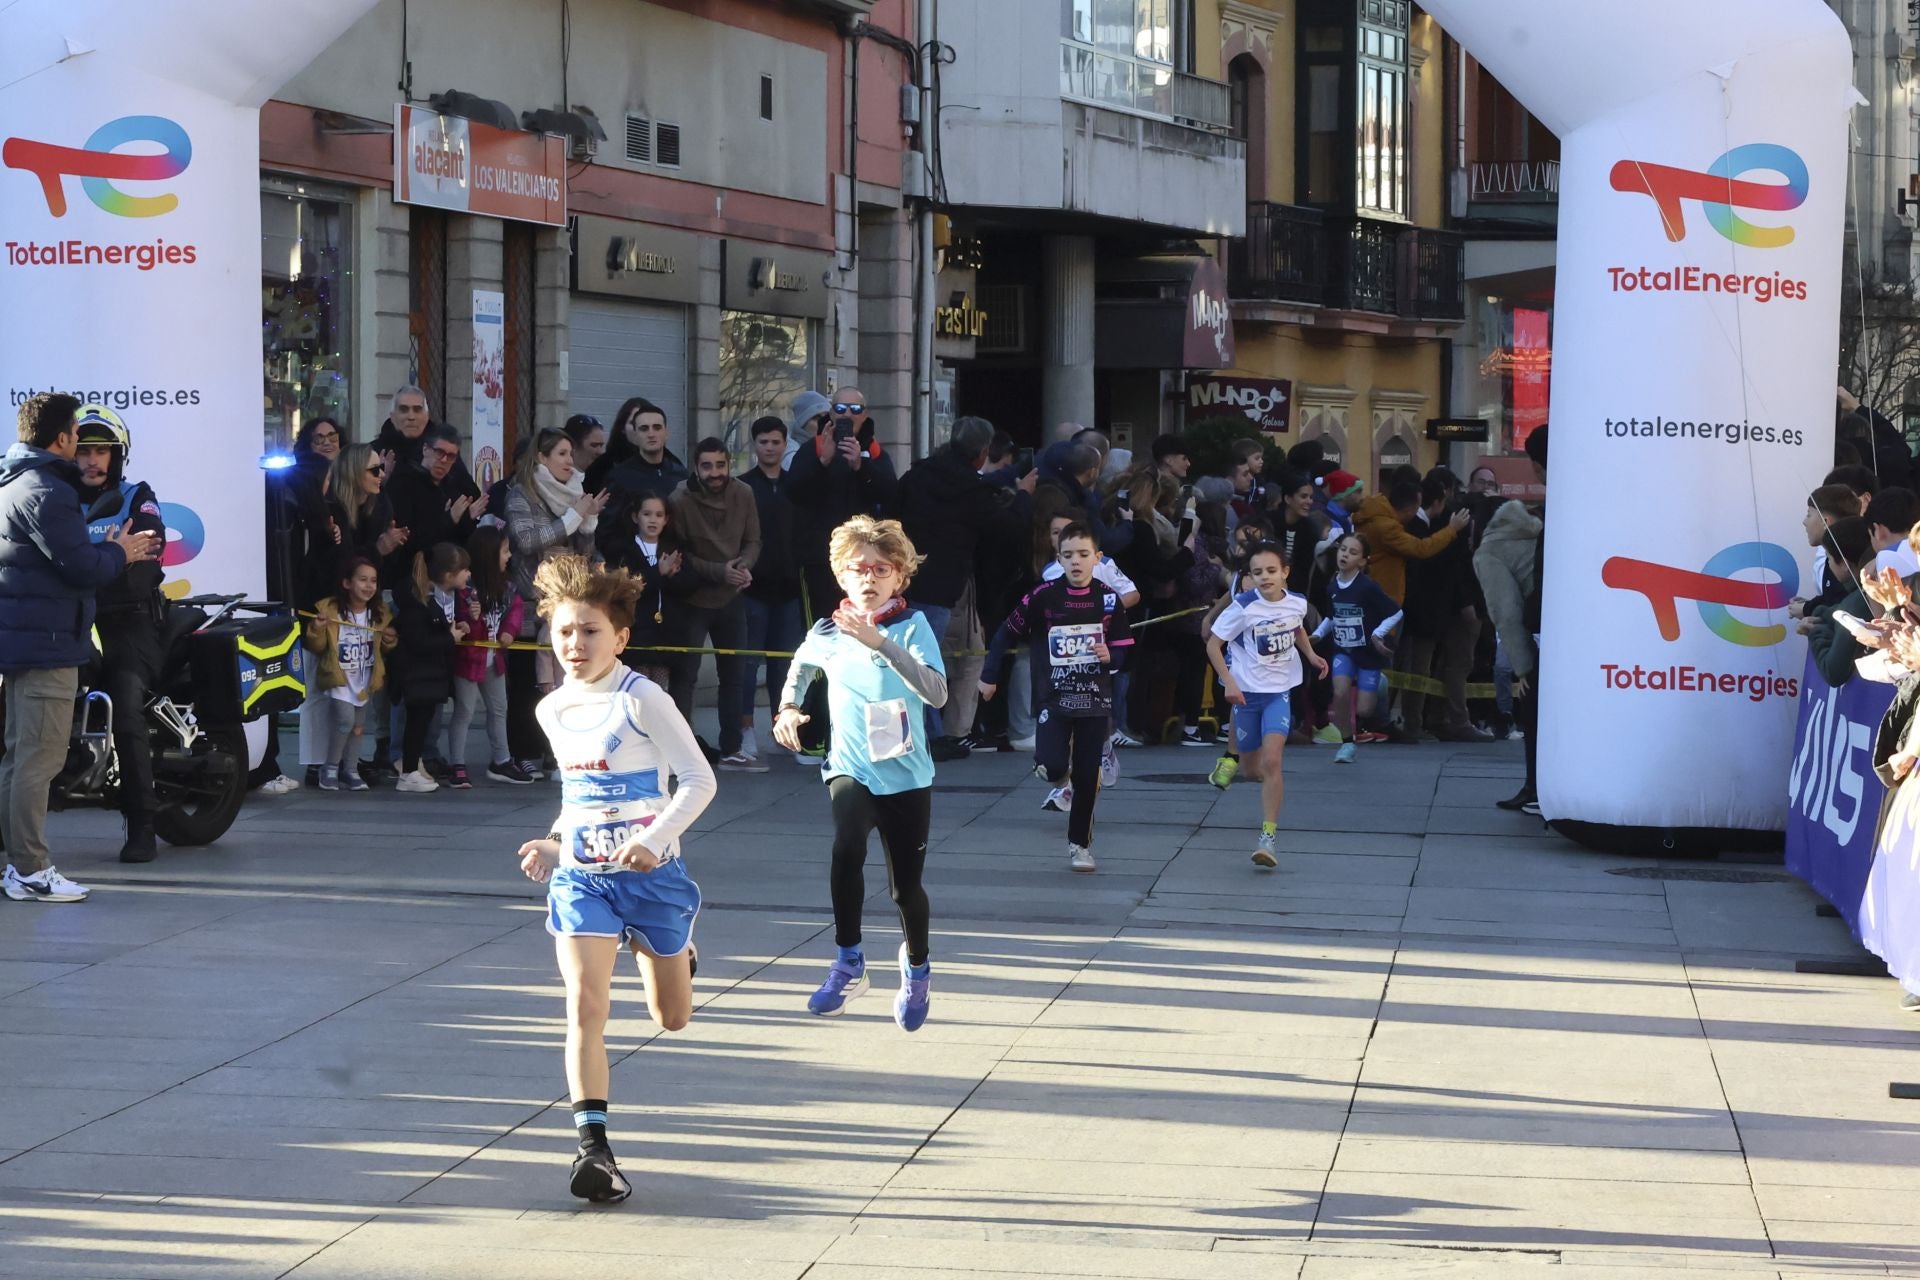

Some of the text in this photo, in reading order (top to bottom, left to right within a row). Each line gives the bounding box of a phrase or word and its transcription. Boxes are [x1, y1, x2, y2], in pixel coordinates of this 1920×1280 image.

[474, 165, 559, 202] LOS VALENCIANOS
[6, 239, 196, 271] TotalEnergies
[1608, 266, 1807, 303] TotalEnergies
[1190, 382, 1274, 412] MUNDO
[1605, 416, 1803, 446] totalenergies.es
[1056, 637, 1096, 655] 3642
[241, 662, 281, 682] 092 GS
[1600, 664, 1798, 702] TotalEnergies
